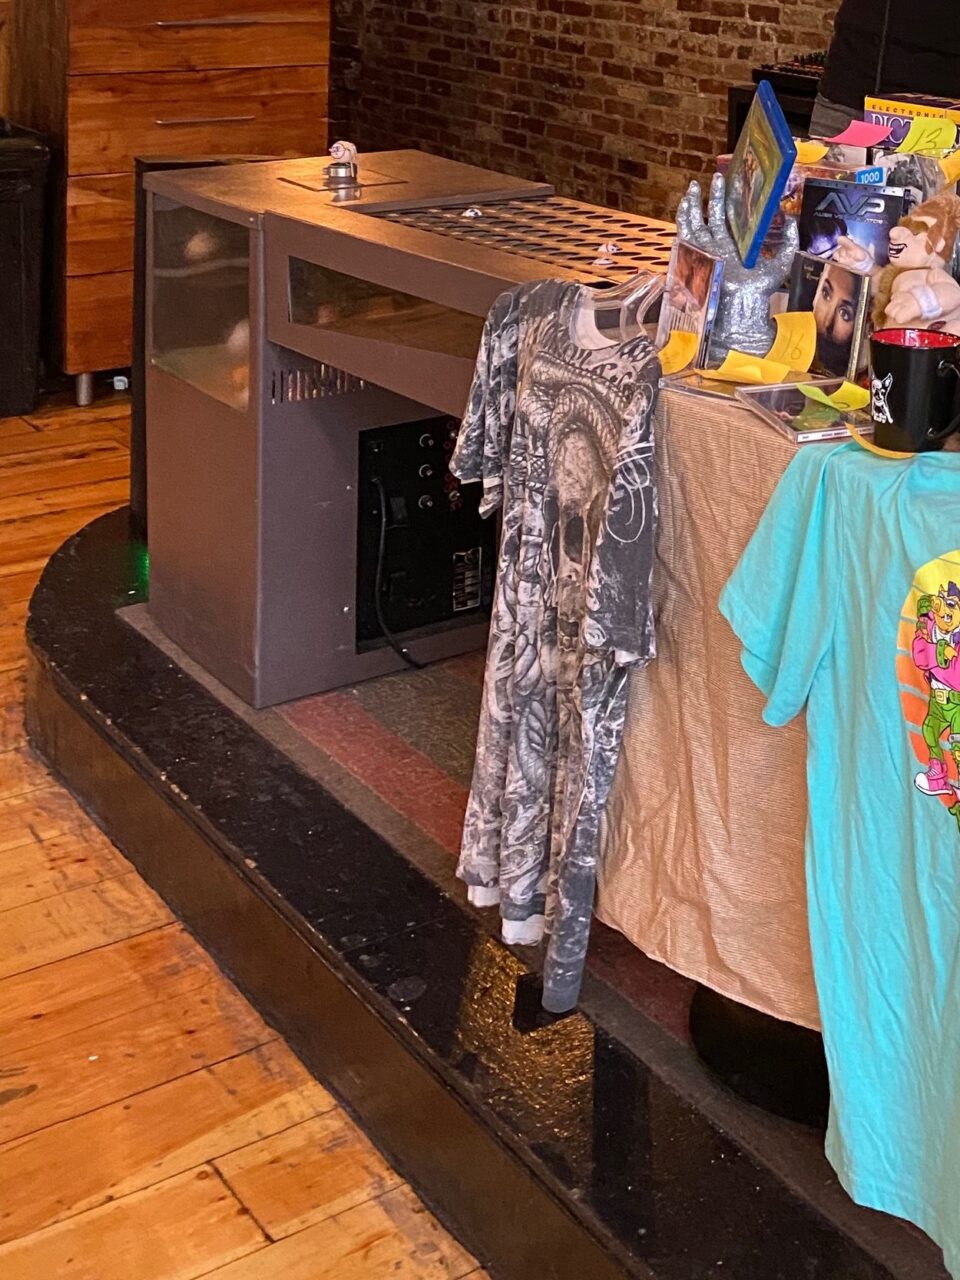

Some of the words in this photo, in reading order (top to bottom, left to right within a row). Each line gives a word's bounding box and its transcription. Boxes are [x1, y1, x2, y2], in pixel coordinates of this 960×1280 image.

[907, 127, 943, 152] 13
[859, 170, 881, 185] 1000
[813, 191, 886, 218] AVP
